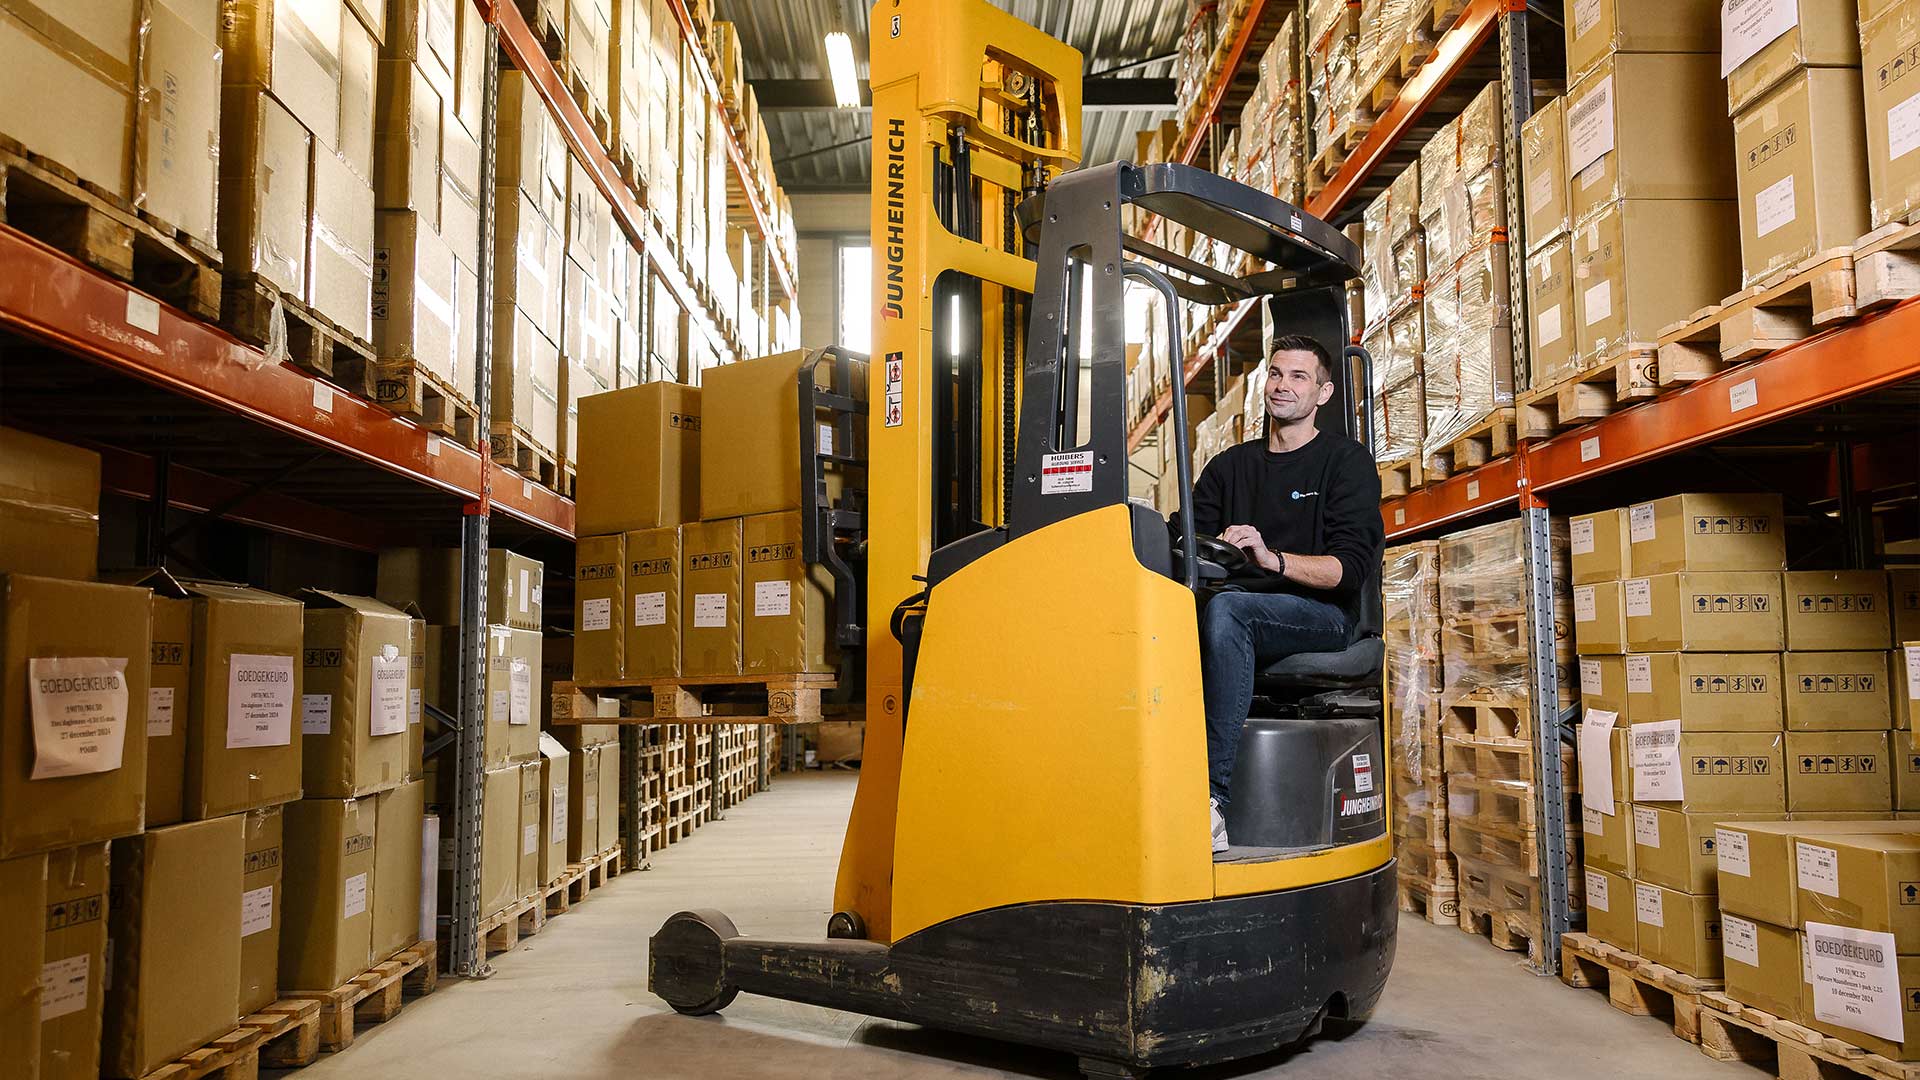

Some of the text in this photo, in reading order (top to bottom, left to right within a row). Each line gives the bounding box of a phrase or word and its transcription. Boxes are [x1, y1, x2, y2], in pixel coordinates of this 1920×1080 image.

[888, 118, 905, 320] JUNGHEINRICH
[1051, 453, 1085, 461] HUIBERS
[237, 670, 288, 683] GOEDGEKEURD
[40, 676, 120, 694] GOEDGEKEURD
[97, 728, 111, 736] 2024
[1635, 733, 1676, 747] GOEDGEKEURD
[1443, 903, 1458, 914] EPA
[1815, 940, 1884, 964] GOEDGEKEURD
[1838, 989, 1861, 1001] december
[1861, 994, 1874, 1004] 2024
